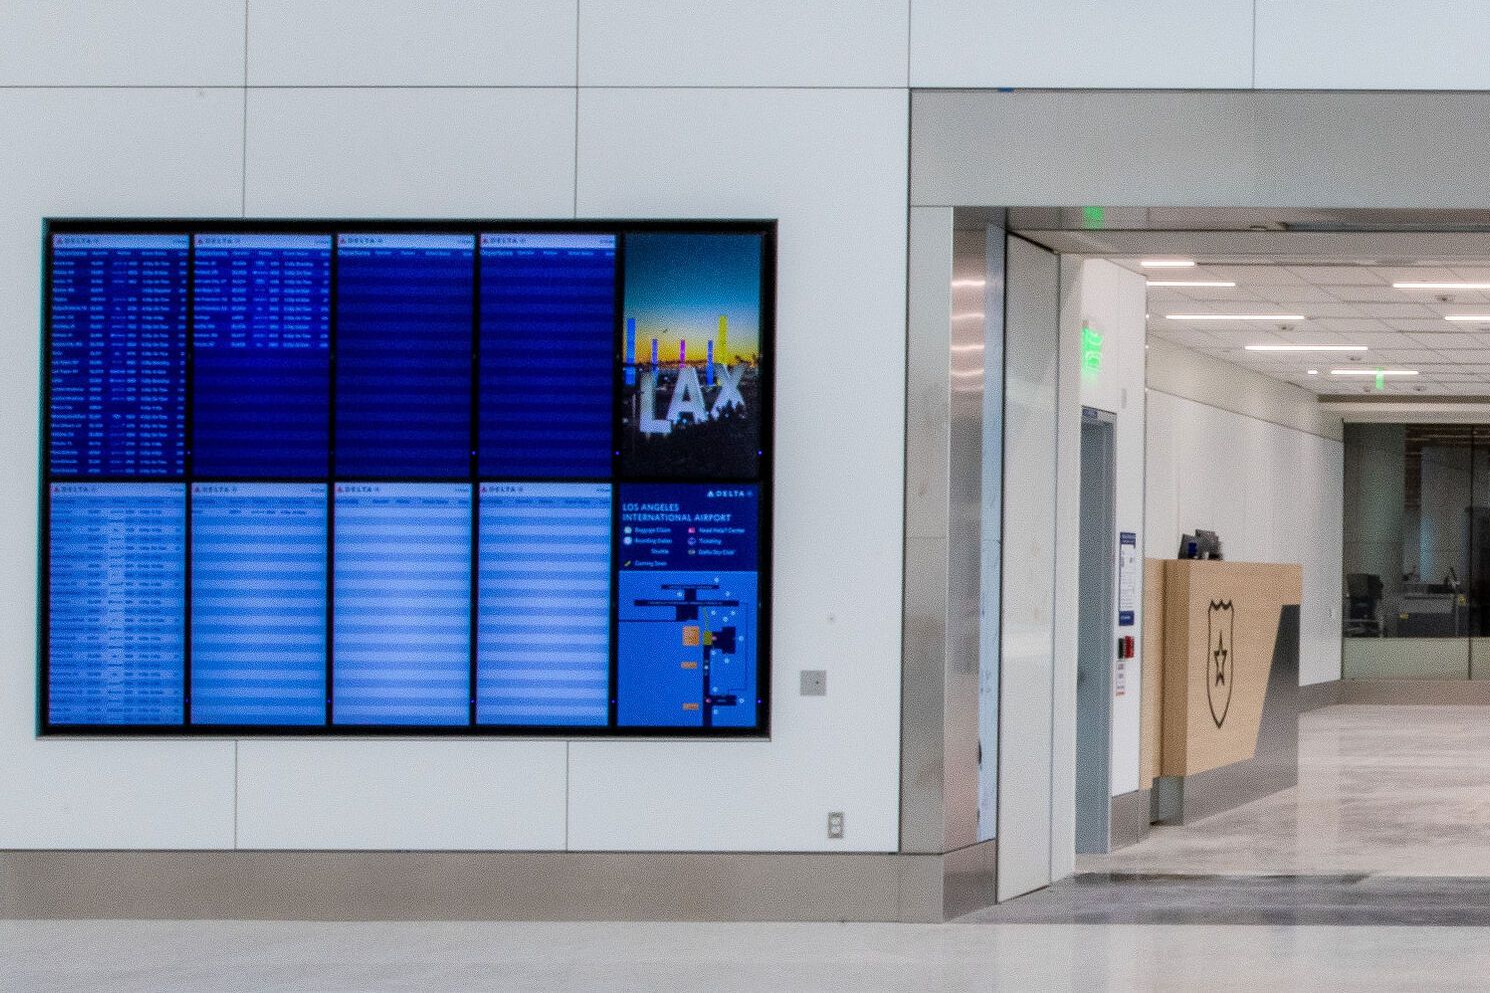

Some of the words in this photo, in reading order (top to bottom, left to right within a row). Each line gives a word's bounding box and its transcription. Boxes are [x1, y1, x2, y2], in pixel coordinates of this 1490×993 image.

[639, 363, 746, 434] LAX
[622, 503, 639, 512] LOS
[640, 503, 680, 512] ANGELES
[622, 513, 692, 522] INTERNATIONAL
[694, 513, 732, 522] AIRPORT
